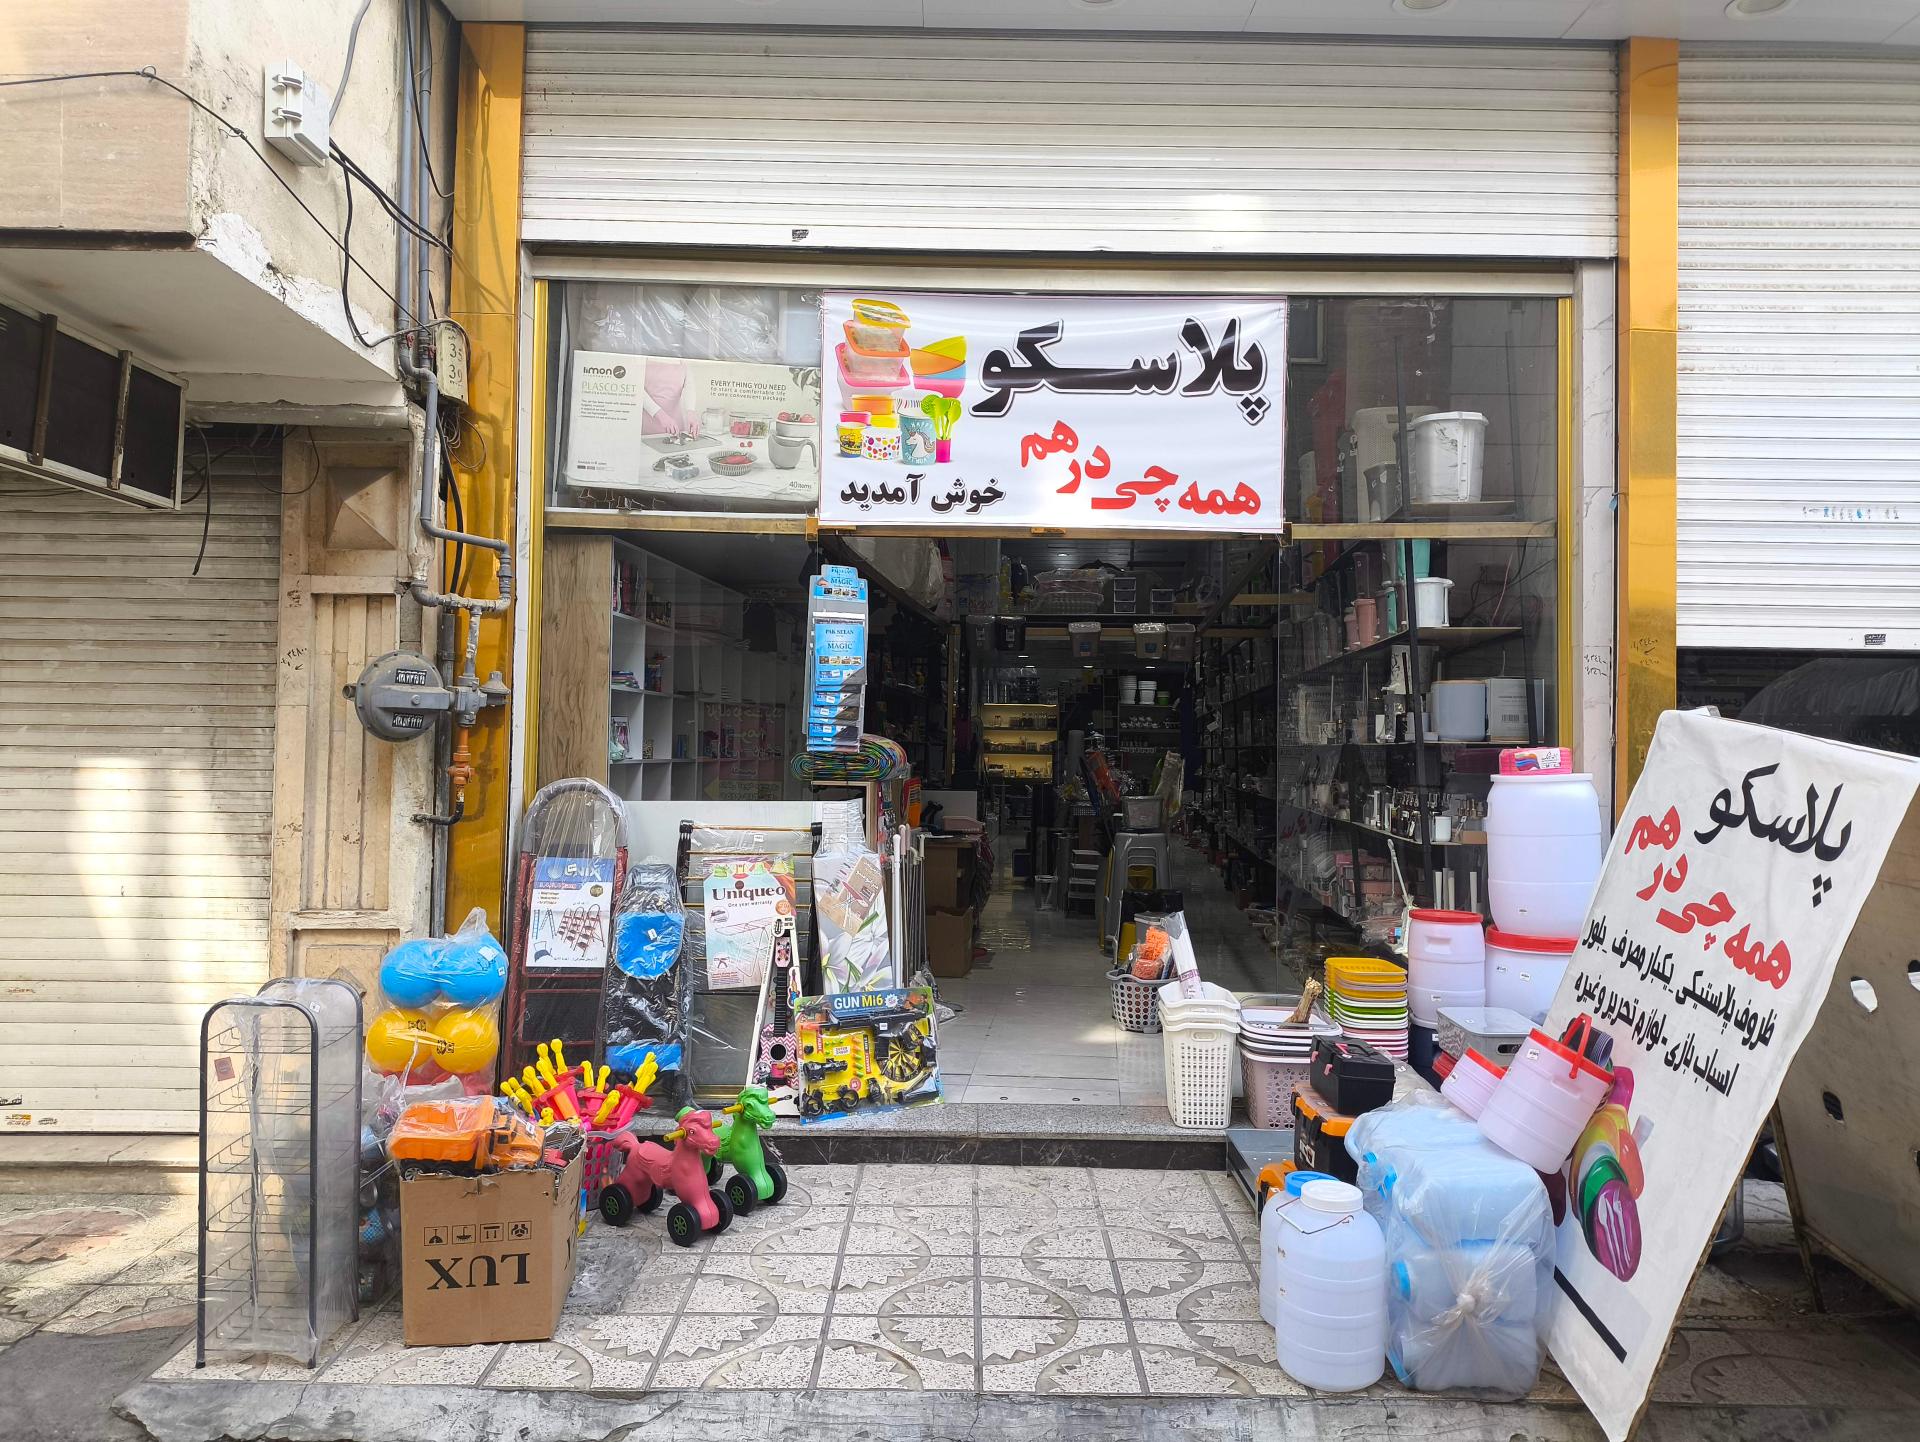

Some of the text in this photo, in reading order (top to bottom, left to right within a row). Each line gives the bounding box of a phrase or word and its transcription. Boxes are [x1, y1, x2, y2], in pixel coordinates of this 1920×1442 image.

[581, 380, 637, 392] PLASCO SET
[710, 379, 730, 387] EVERY
[732, 381, 752, 389] THING
[754, 382, 768, 390] YOU
[970, 317, 1268, 424] پلاسکو
[840, 473, 1004, 513] خوش آمدید
[1090, 465, 1180, 514] چی
[1178, 481, 1262, 516] همه
[827, 642, 853, 650] MAGIC
[1694, 762, 1853, 908] پلاسکو
[1656, 891, 1737, 951] چی
[1723, 923, 1792, 990] همه
[833, 993, 884, 1010] GUN Mi6
[1601, 990, 1639, 1027] تحریر
[1675, 970, 1736, 1035] پلاستیکی
[1631, 1008, 1667, 1051] لوازم
[1733, 999, 1777, 1050] ظروف
[1663, 1032, 1695, 1075] بازی
[1693, 1048, 1740, 1097] اسباب
[424, 1252, 531, 1291] LUX
